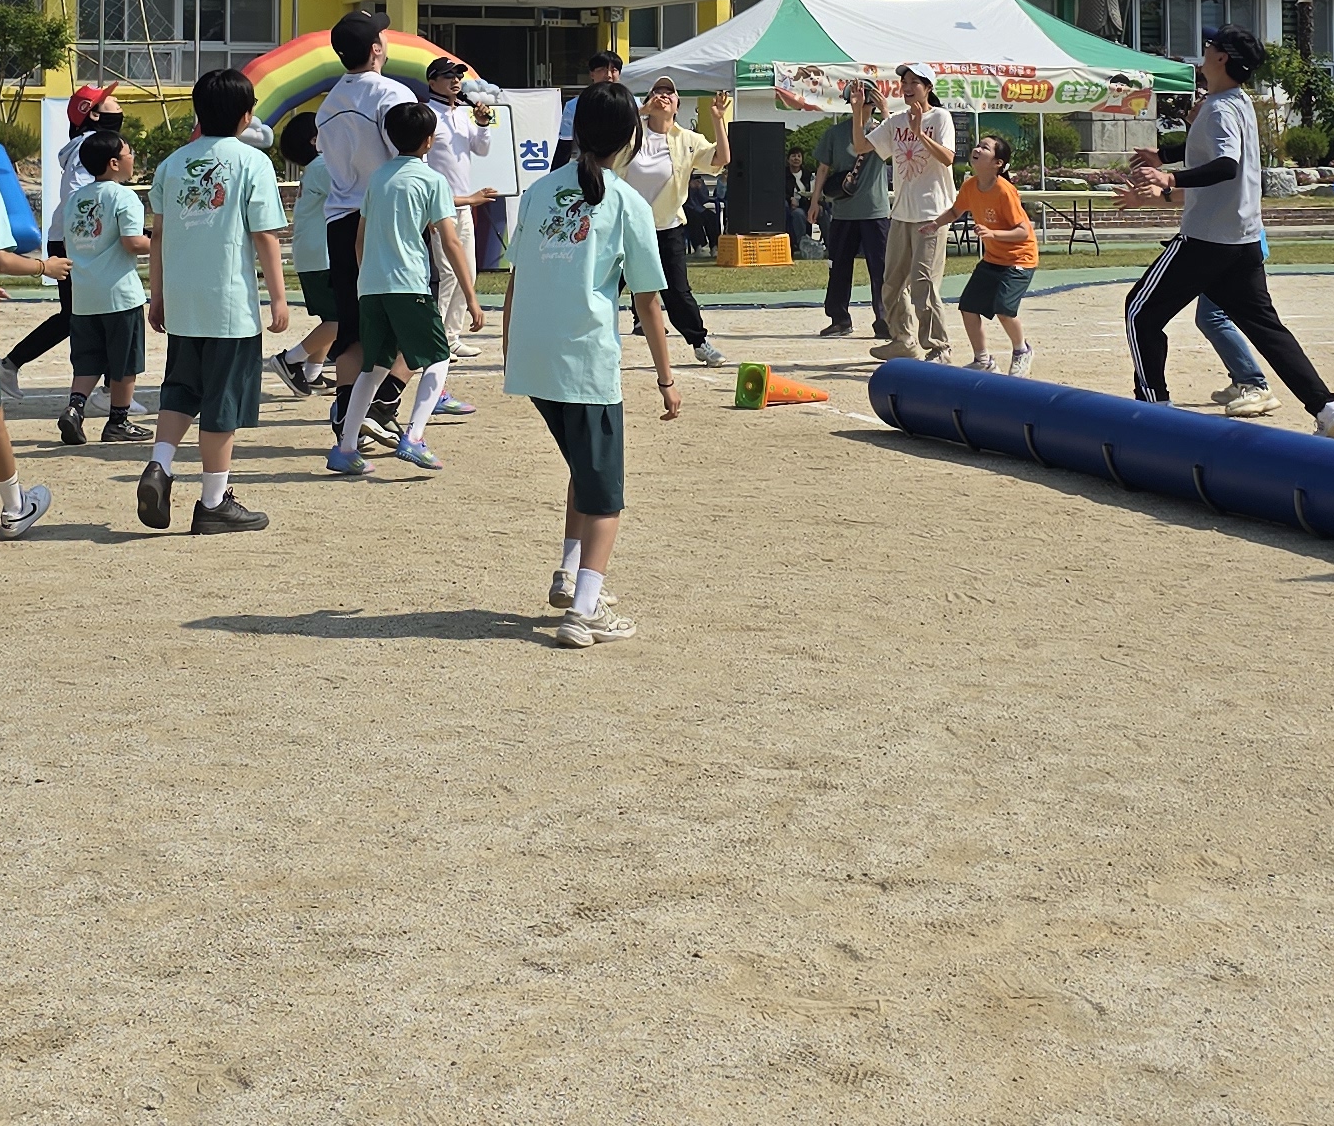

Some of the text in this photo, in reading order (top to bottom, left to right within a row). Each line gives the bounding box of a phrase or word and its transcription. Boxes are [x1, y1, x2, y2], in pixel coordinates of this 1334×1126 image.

[970, 79, 1000, 99] 피는
[1007, 82, 1048, 101] 버드내
[1061, 84, 1102, 101] 운동회
[519, 139, 550, 171] 청
